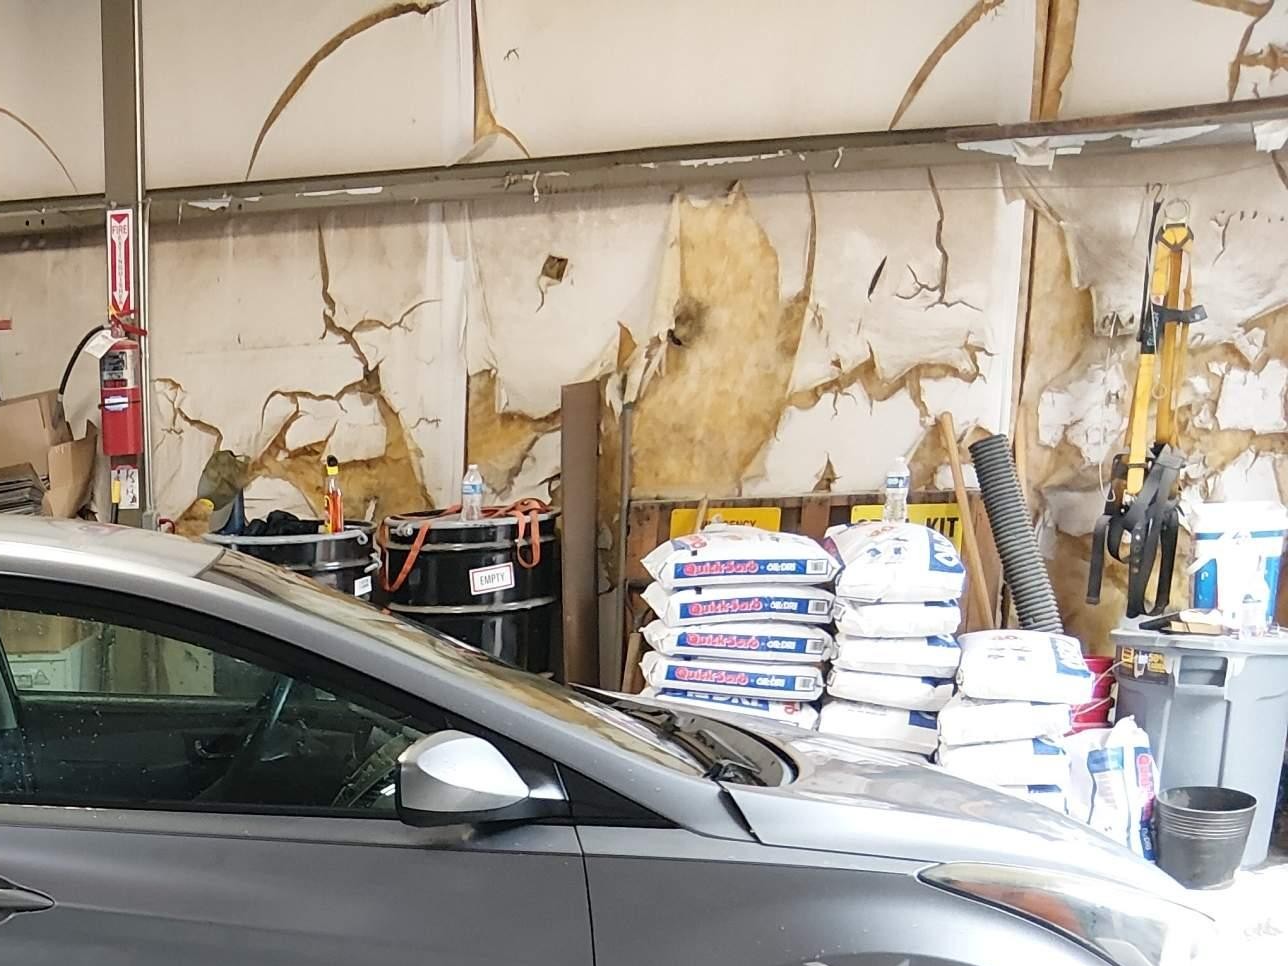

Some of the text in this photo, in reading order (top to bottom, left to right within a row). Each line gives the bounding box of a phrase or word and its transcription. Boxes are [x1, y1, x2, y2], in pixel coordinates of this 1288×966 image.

[112, 225, 128, 235] FIRE
[926, 517, 959, 538] KIT
[480, 572, 505, 586] EMPTY
